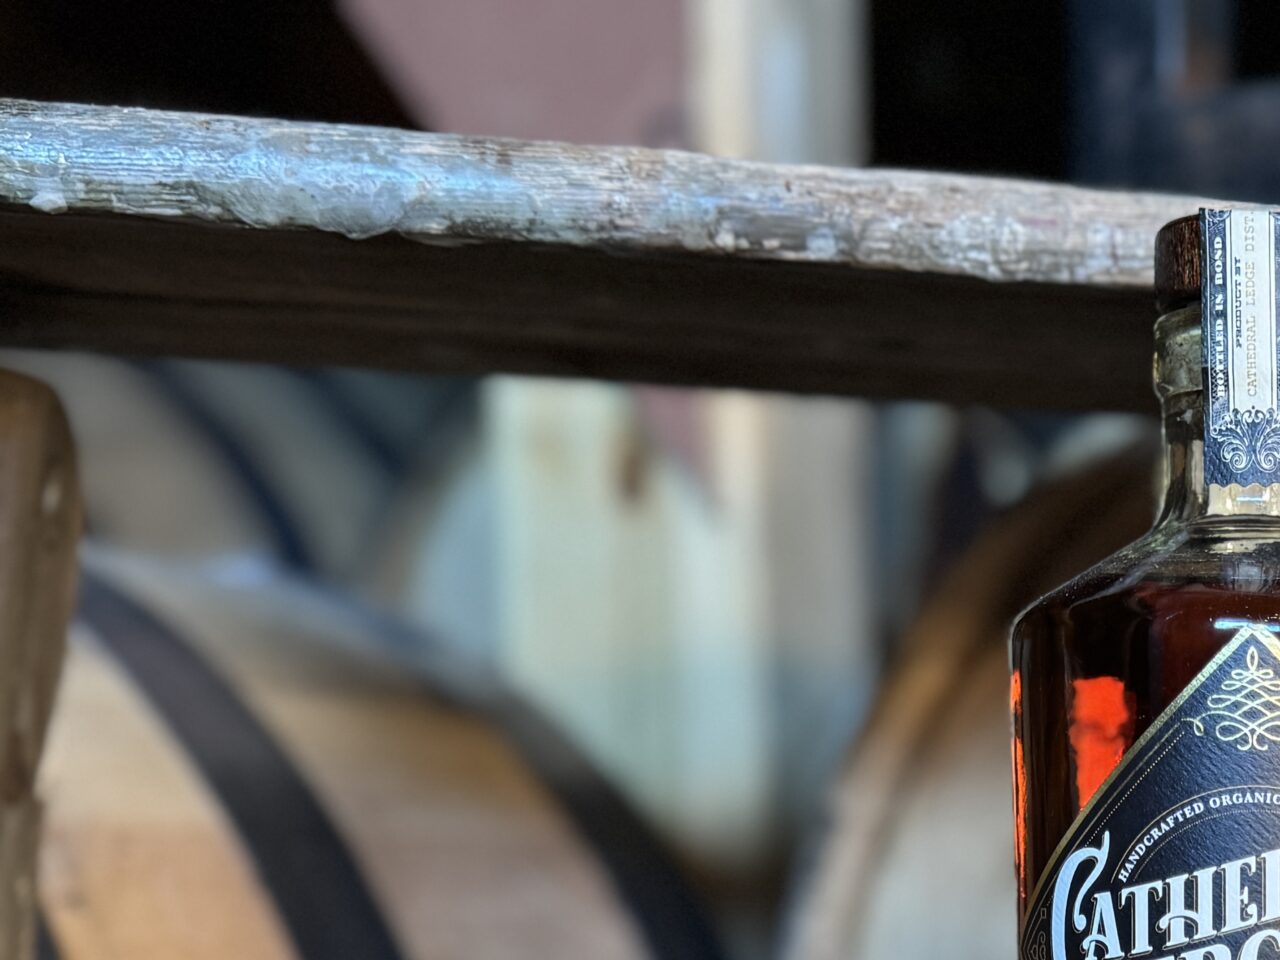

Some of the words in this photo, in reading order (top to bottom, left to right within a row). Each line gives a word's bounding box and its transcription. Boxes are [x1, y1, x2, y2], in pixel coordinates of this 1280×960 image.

[1213, 236, 1223, 285] BOND
[1244, 262, 1256, 306] LEDGE
[1214, 293, 1224, 311] IN
[1234, 281, 1242, 348] PRODUCT
[1215, 319, 1226, 398] BOTTLED
[1246, 316, 1257, 397] CATHEDRAL
[1118, 802, 1204, 883] HANDCRAFTED
